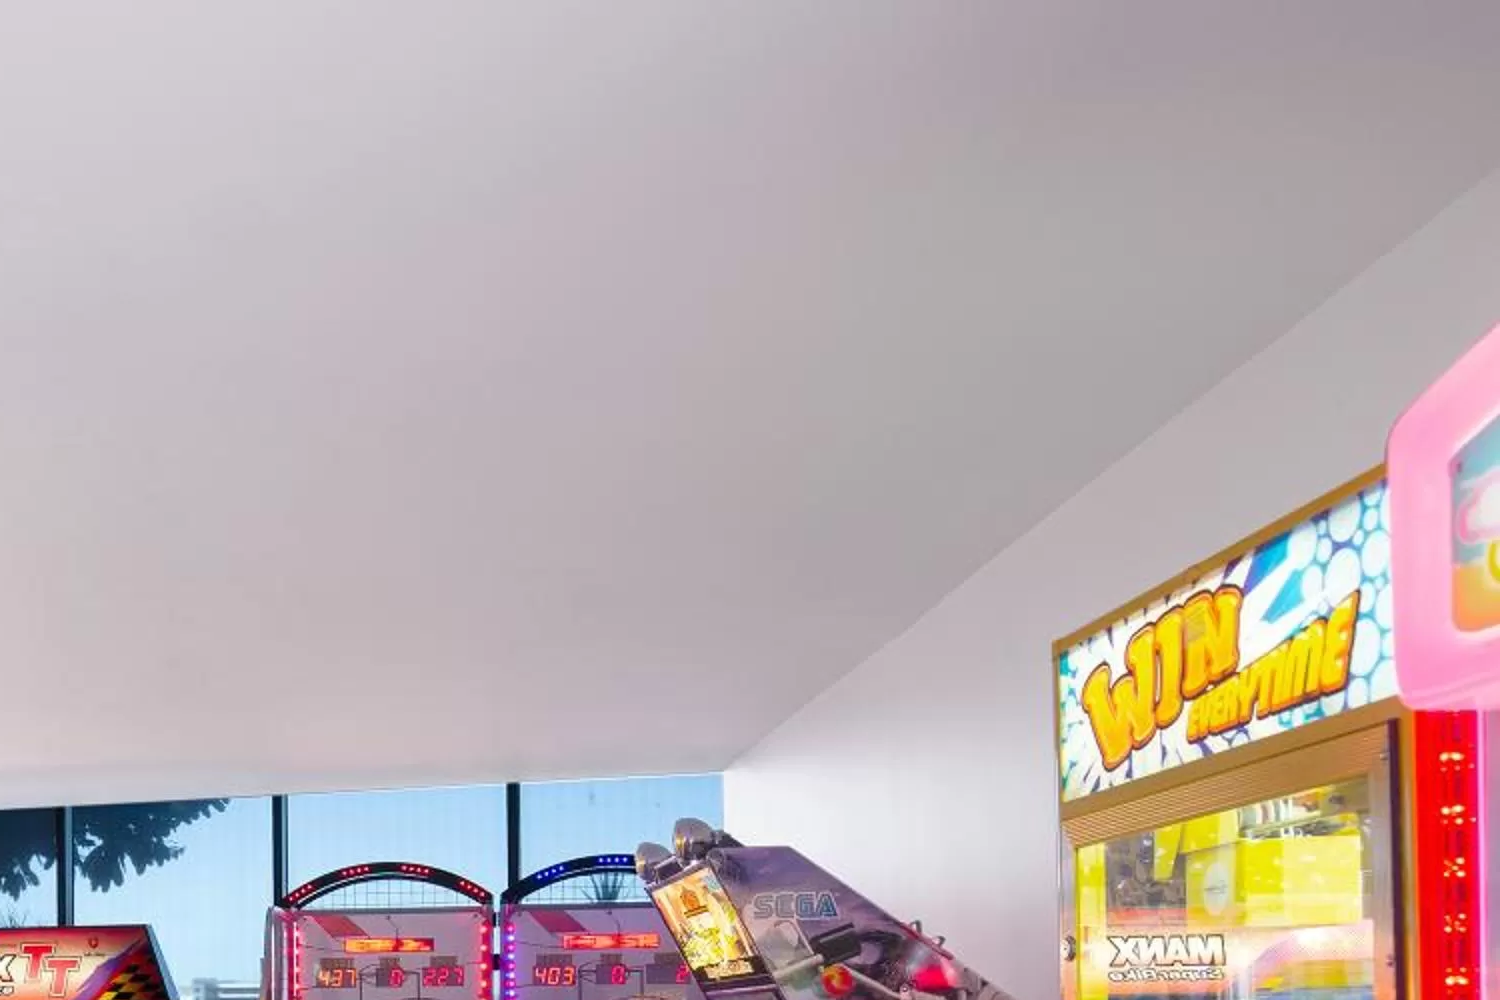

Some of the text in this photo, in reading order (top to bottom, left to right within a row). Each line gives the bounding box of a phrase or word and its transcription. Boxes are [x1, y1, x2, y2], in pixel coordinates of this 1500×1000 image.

[1081, 585, 1241, 770] WIN
[754, 892, 837, 919] SEGA
[318, 969, 357, 988] 437
[423, 967, 464, 987] 227
[535, 966, 575, 986] 403
